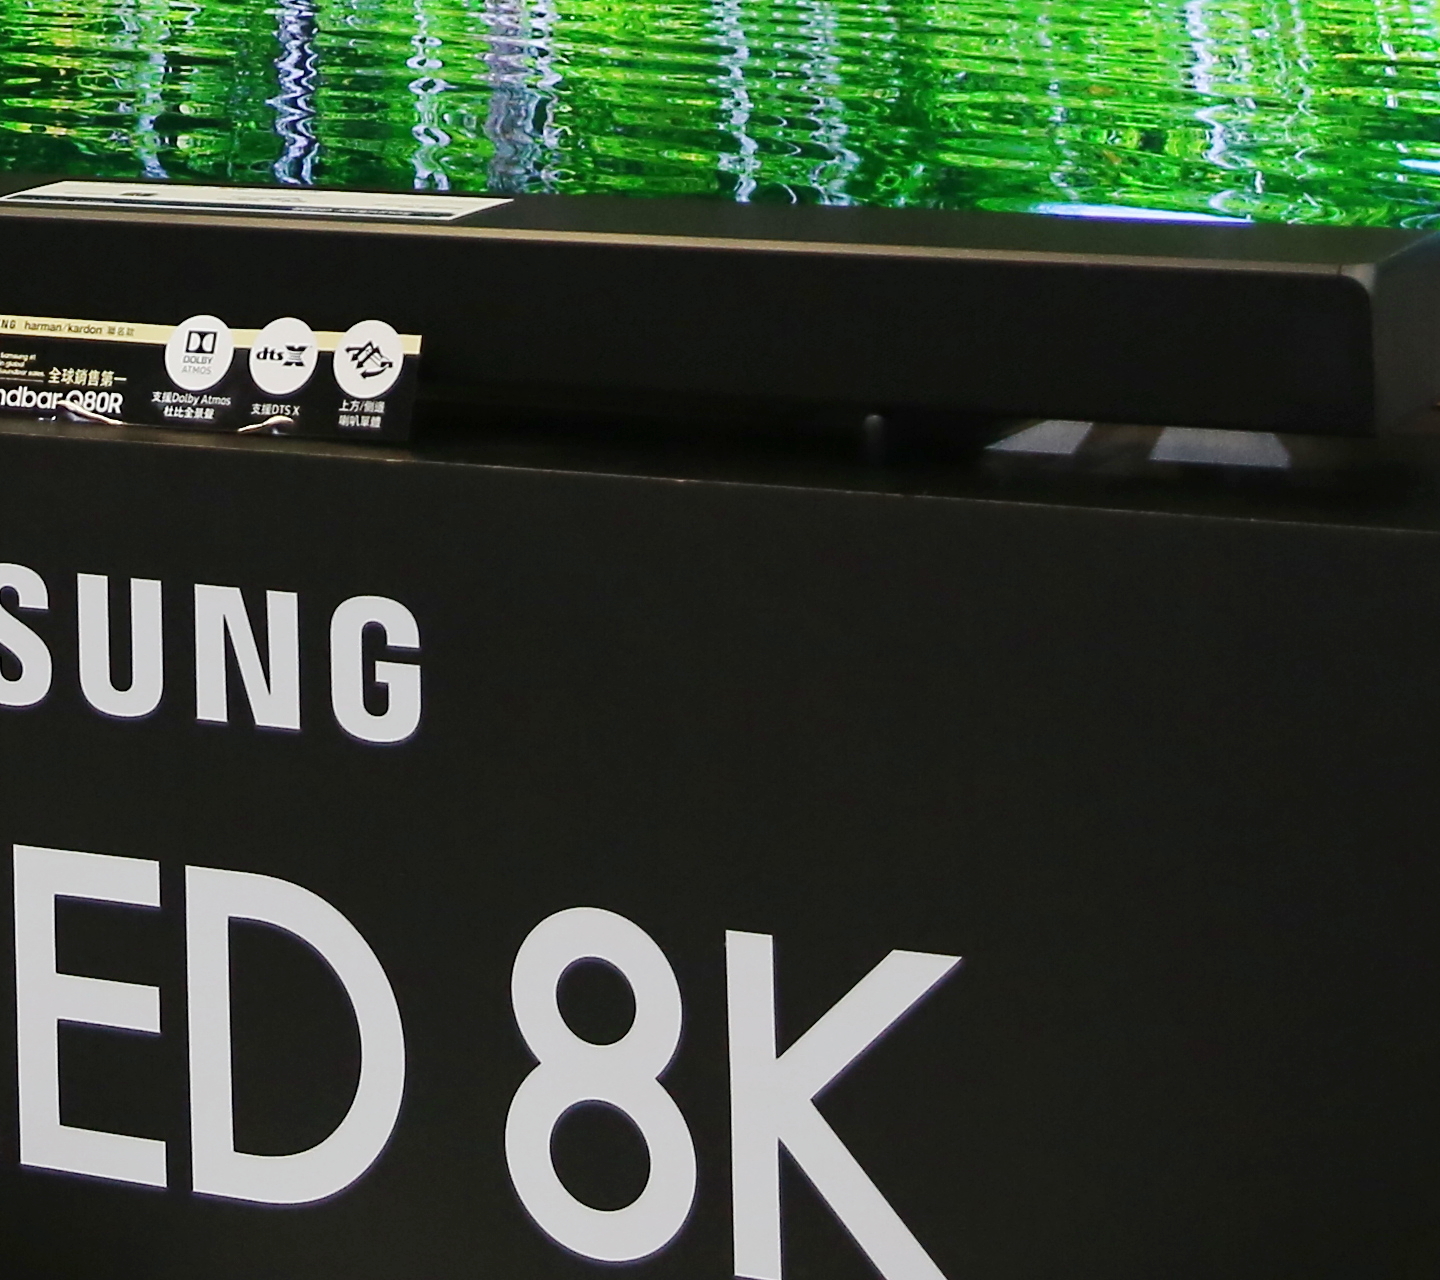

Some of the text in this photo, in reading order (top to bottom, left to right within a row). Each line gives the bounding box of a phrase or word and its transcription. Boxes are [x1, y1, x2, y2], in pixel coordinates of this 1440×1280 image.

[24, 321, 103, 335] harman/kardon
[182, 355, 213, 365] DOLBY
[48, 367, 128, 387] 全球銷售第一
[181, 366, 212, 375] ATMOS
[64, 389, 124, 414] Q80R
[504, 906, 964, 1280] 8K
